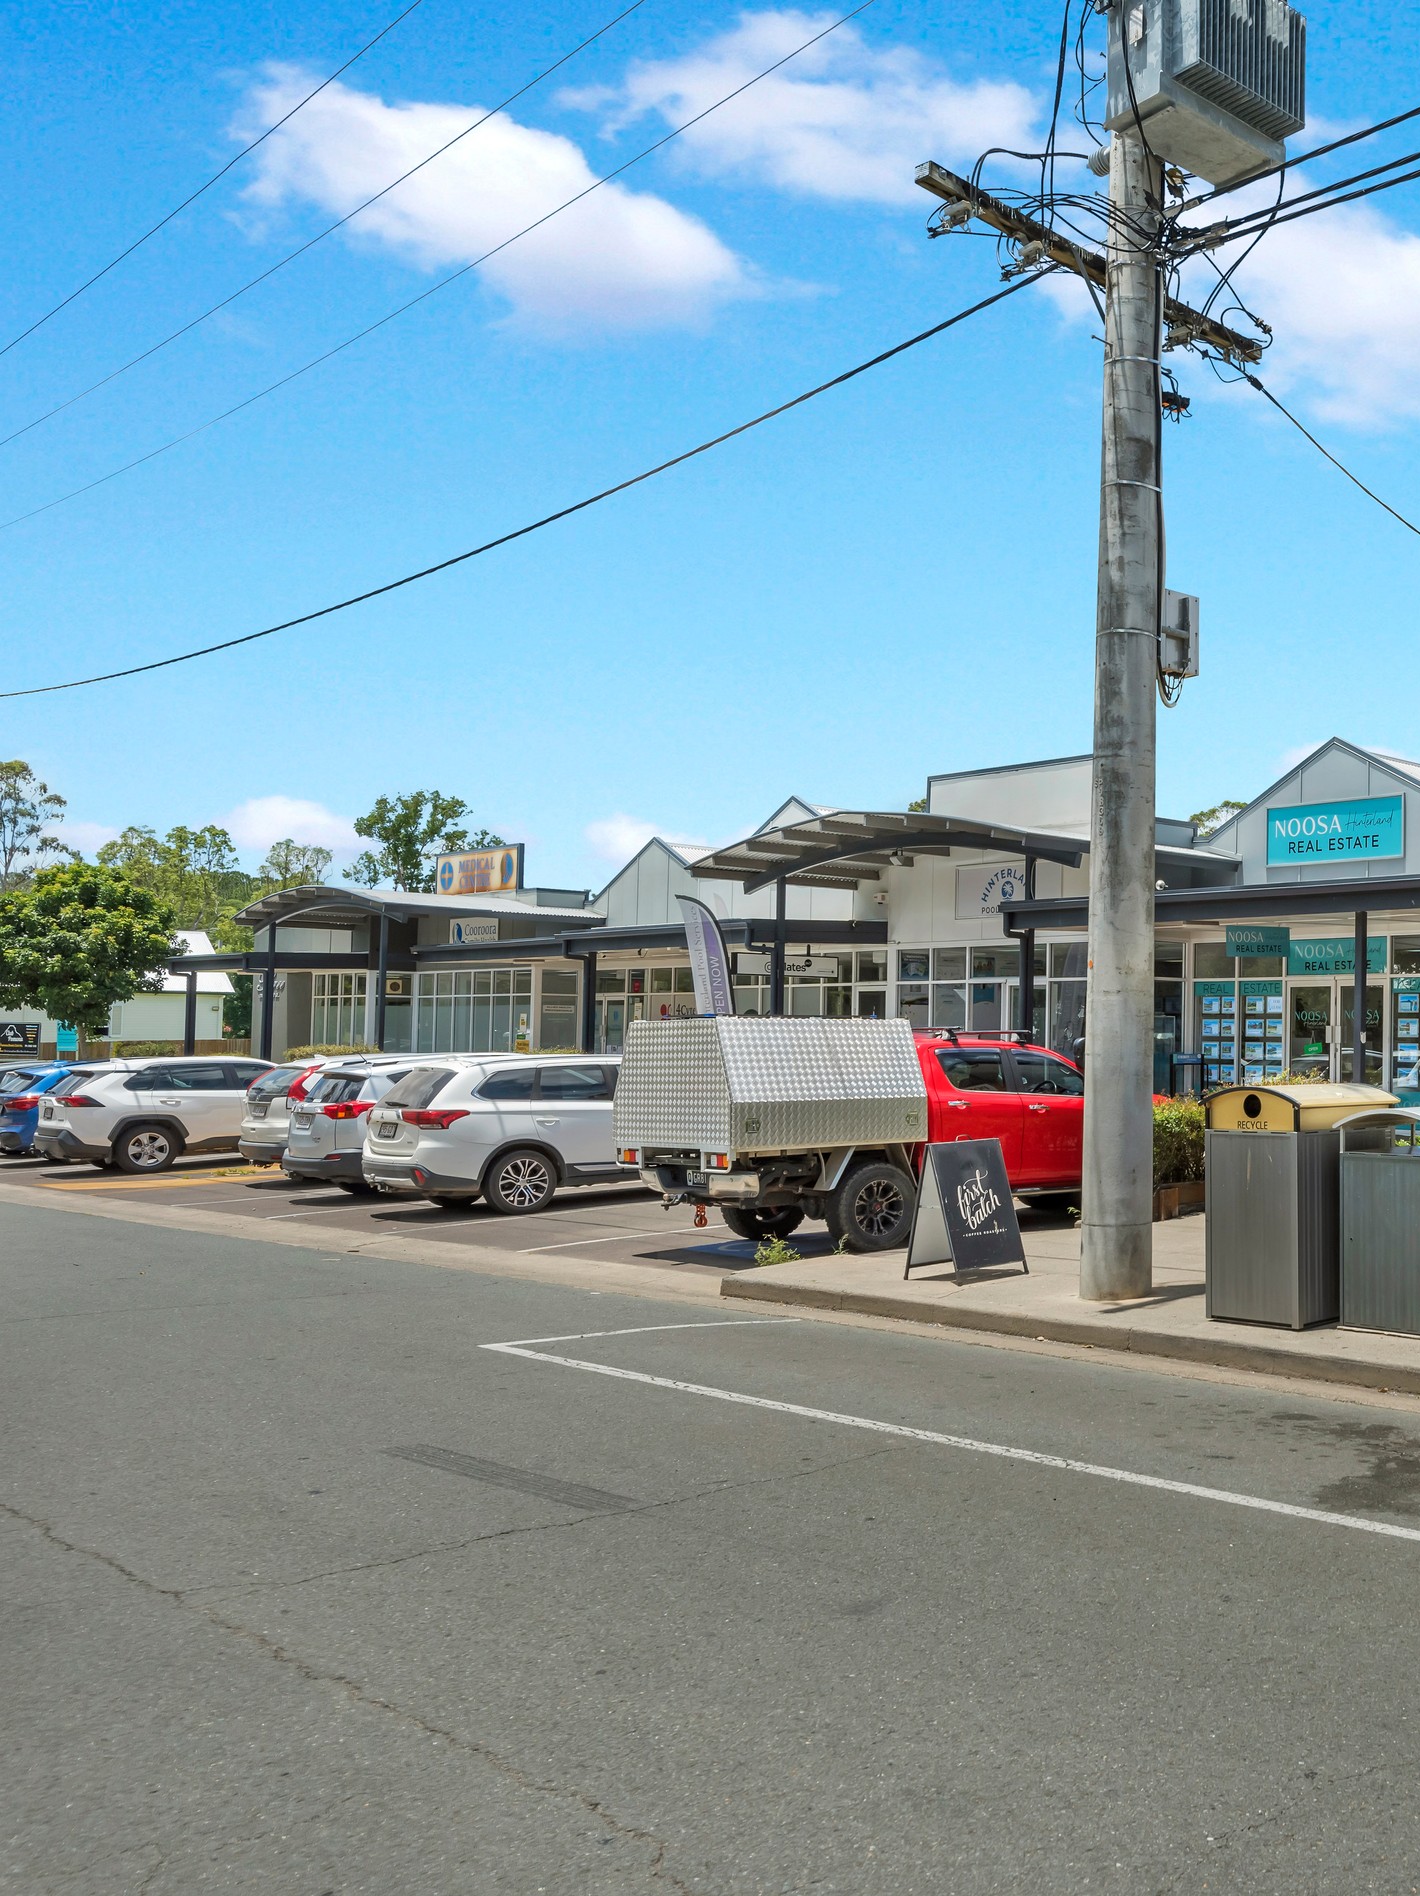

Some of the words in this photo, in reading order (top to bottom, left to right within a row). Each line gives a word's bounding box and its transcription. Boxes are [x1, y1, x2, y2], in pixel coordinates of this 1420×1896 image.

[1275, 814, 1342, 838] NOOSA
[1345, 808, 1394, 831] Hinterland
[1288, 840, 1323, 854] REAL
[1328, 834, 1379, 851] ESTATE
[458, 857, 495, 874] MEDICAL
[981, 868, 1026, 902] HINTERLA
[464, 924, 497, 936] Cooroora
[1228, 931, 1264, 943] NOOSA
[1236, 944, 1255, 953] REAL
[1256, 944, 1282, 953] ESTATE
[1295, 943, 1344, 959] NOOSA
[708, 956, 722, 987] NOW
[1304, 961, 1330, 971] REAL
[1334, 959, 1371, 971] ESTE
[1203, 983, 1229, 994] REAL
[1243, 982, 1281, 994] ESTATE
[711, 989, 725, 1014] PEN
[1295, 1011, 1327, 1021] NOOSA
[1237, 1120, 1268, 1130] RECYCLE
[957, 1169, 988, 1220] first
[966, 1188, 1001, 1230] batch
